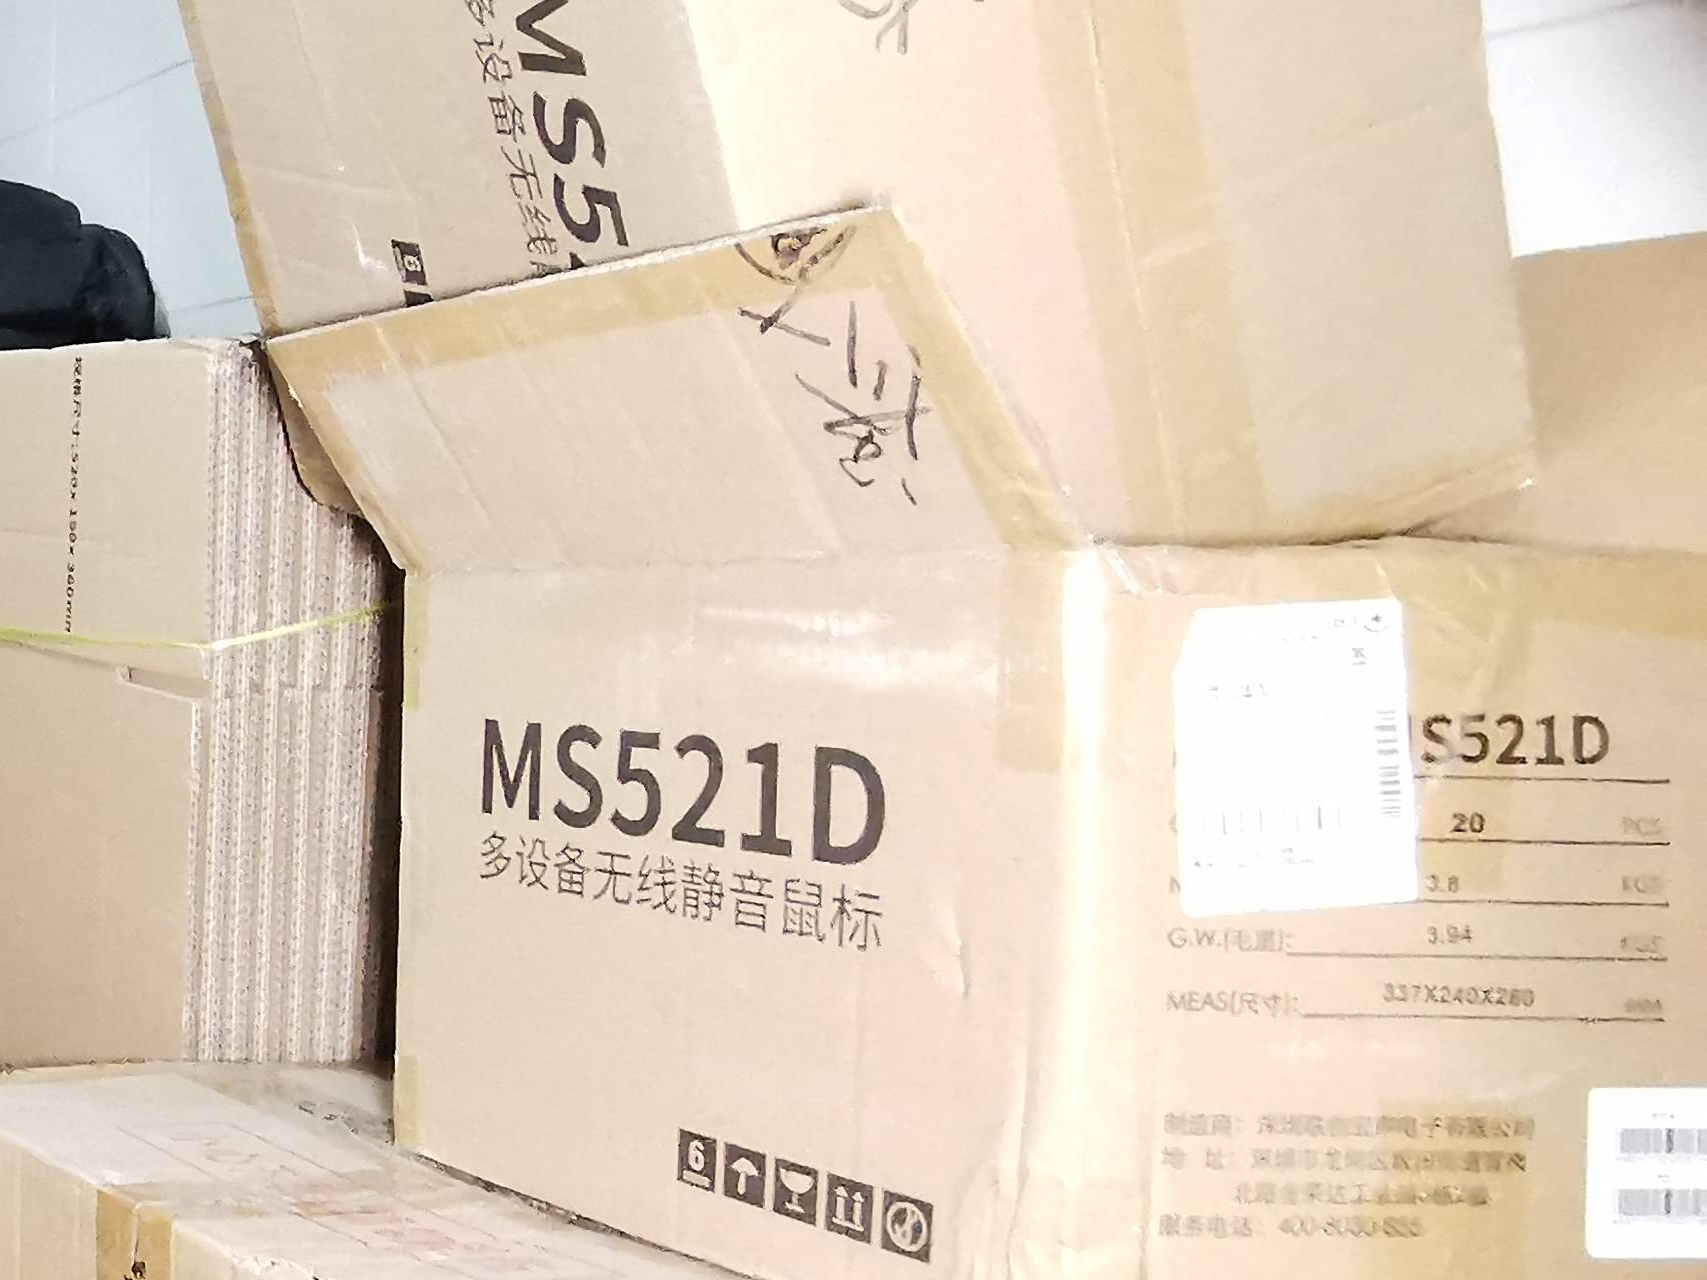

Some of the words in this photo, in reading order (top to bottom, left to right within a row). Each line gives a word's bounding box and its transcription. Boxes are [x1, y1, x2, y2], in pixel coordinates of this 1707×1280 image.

[1409, 712, 1612, 768] S521D
[481, 718, 886, 866] MS521D
[1450, 812, 1486, 834] 20
[478, 830, 884, 953] 多设备无线静音鼠标
